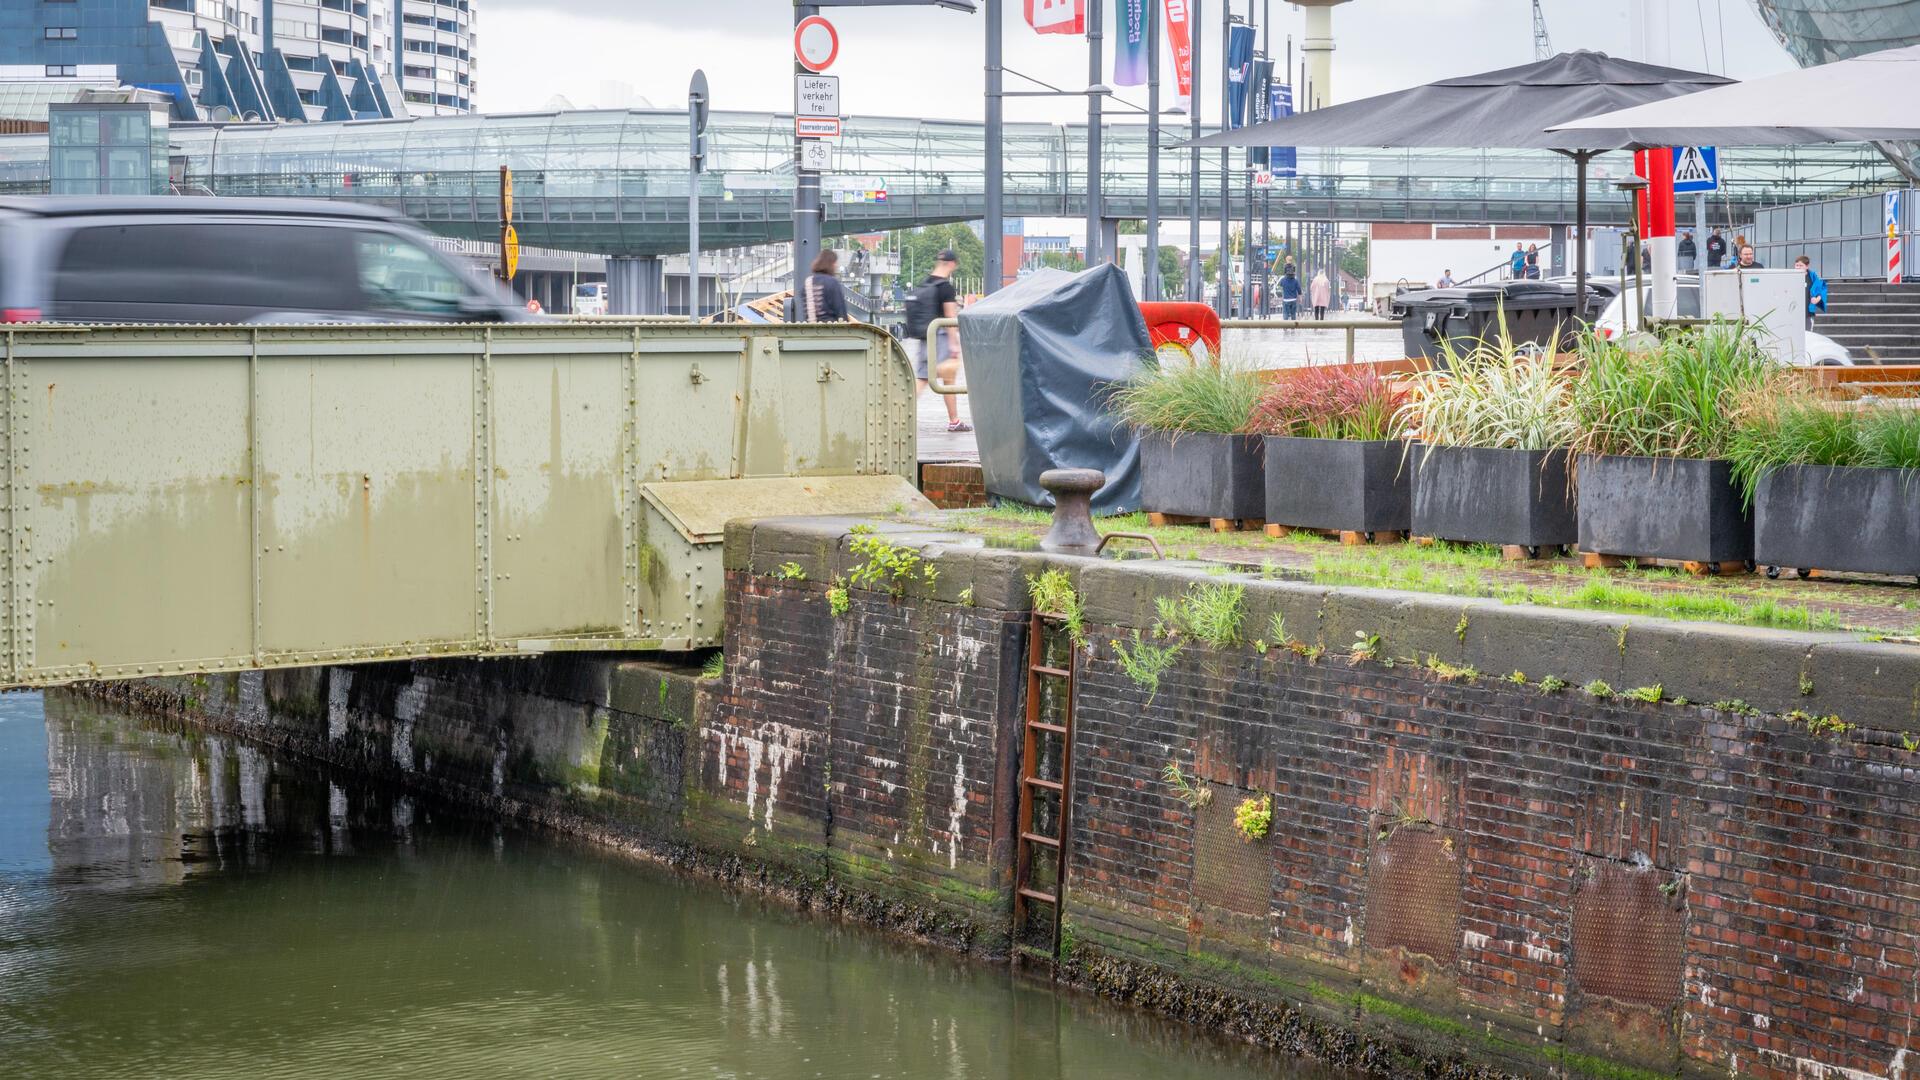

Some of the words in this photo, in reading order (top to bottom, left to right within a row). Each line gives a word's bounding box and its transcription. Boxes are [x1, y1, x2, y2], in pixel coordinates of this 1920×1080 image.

[804, 79, 831, 89] Liefer-
[802, 92, 833, 101] verkehr
[811, 102, 825, 112] frei
